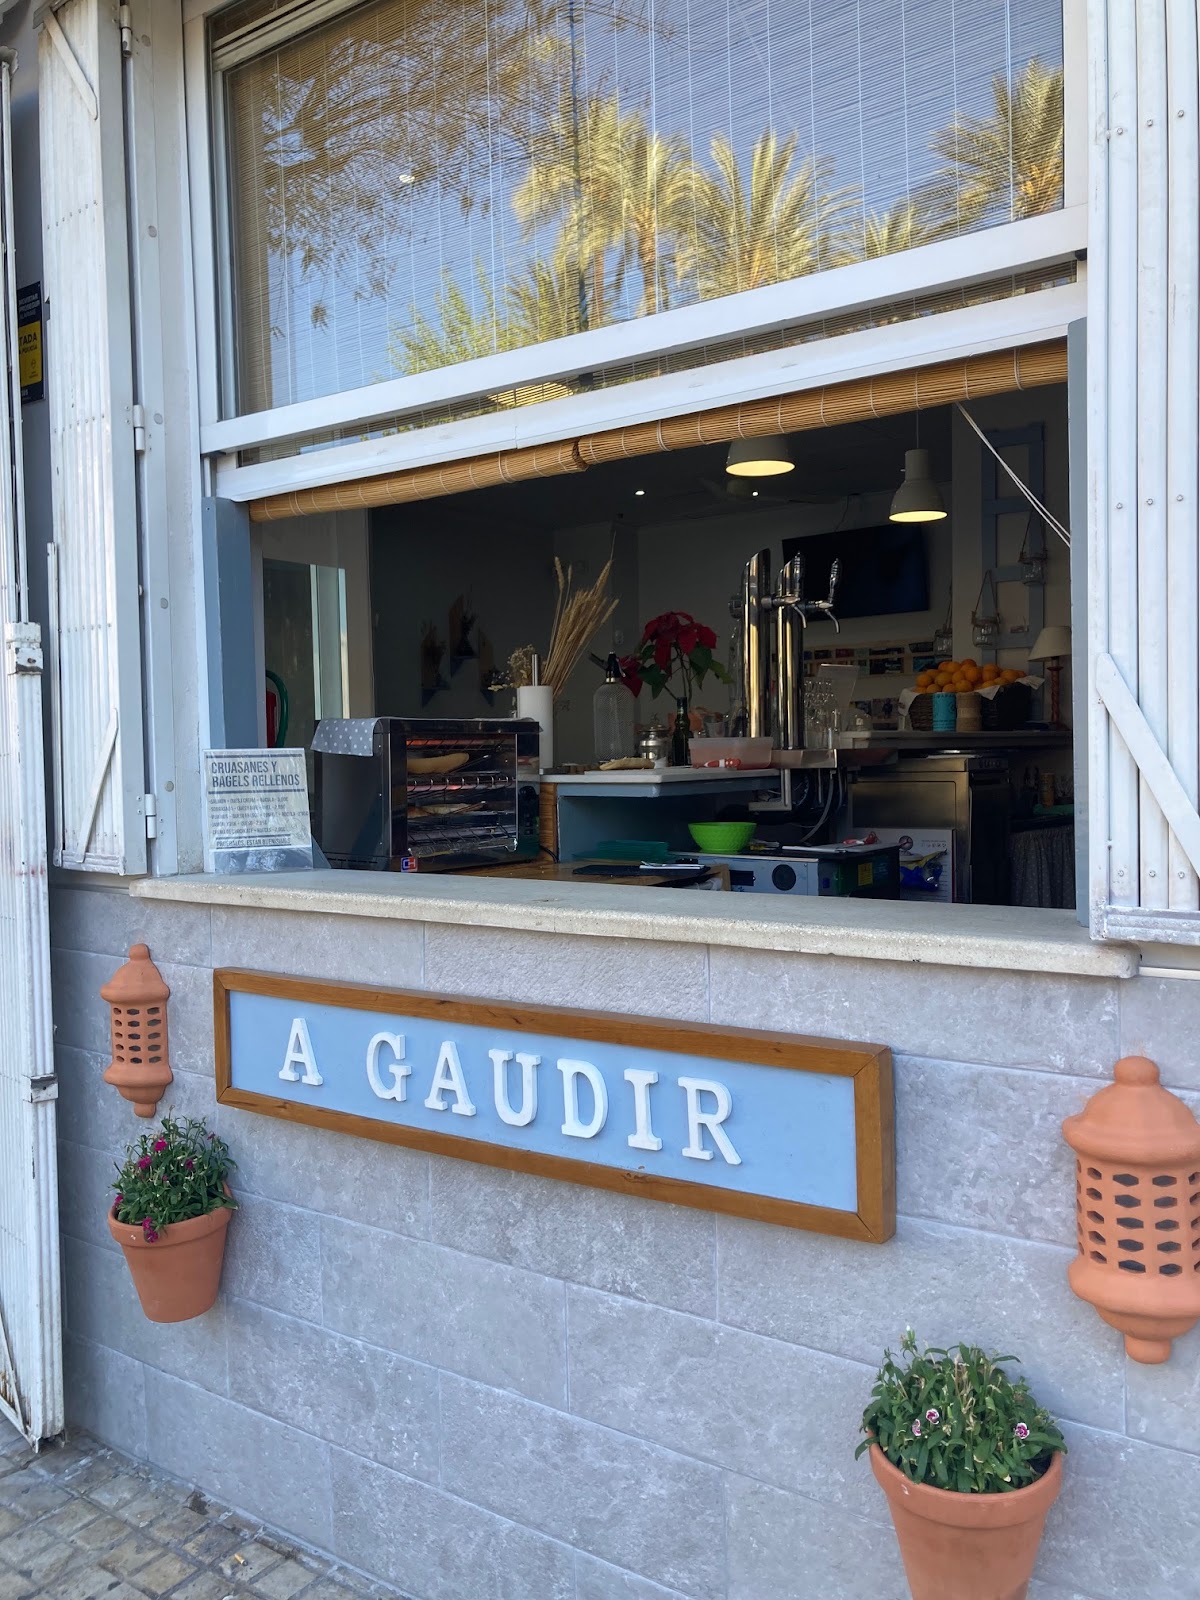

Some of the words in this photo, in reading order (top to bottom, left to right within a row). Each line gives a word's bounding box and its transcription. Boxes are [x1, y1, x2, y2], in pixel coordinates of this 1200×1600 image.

[20, 332, 37, 346] TADA
[211, 761, 268, 774] CRUASANES
[271, 761, 277, 772] Y
[212, 775, 250, 787] BAGELS
[252, 774, 300, 787] RELLENOS
[278, 1017, 323, 1086] A
[366, 1031, 742, 1166] GAUDIR
